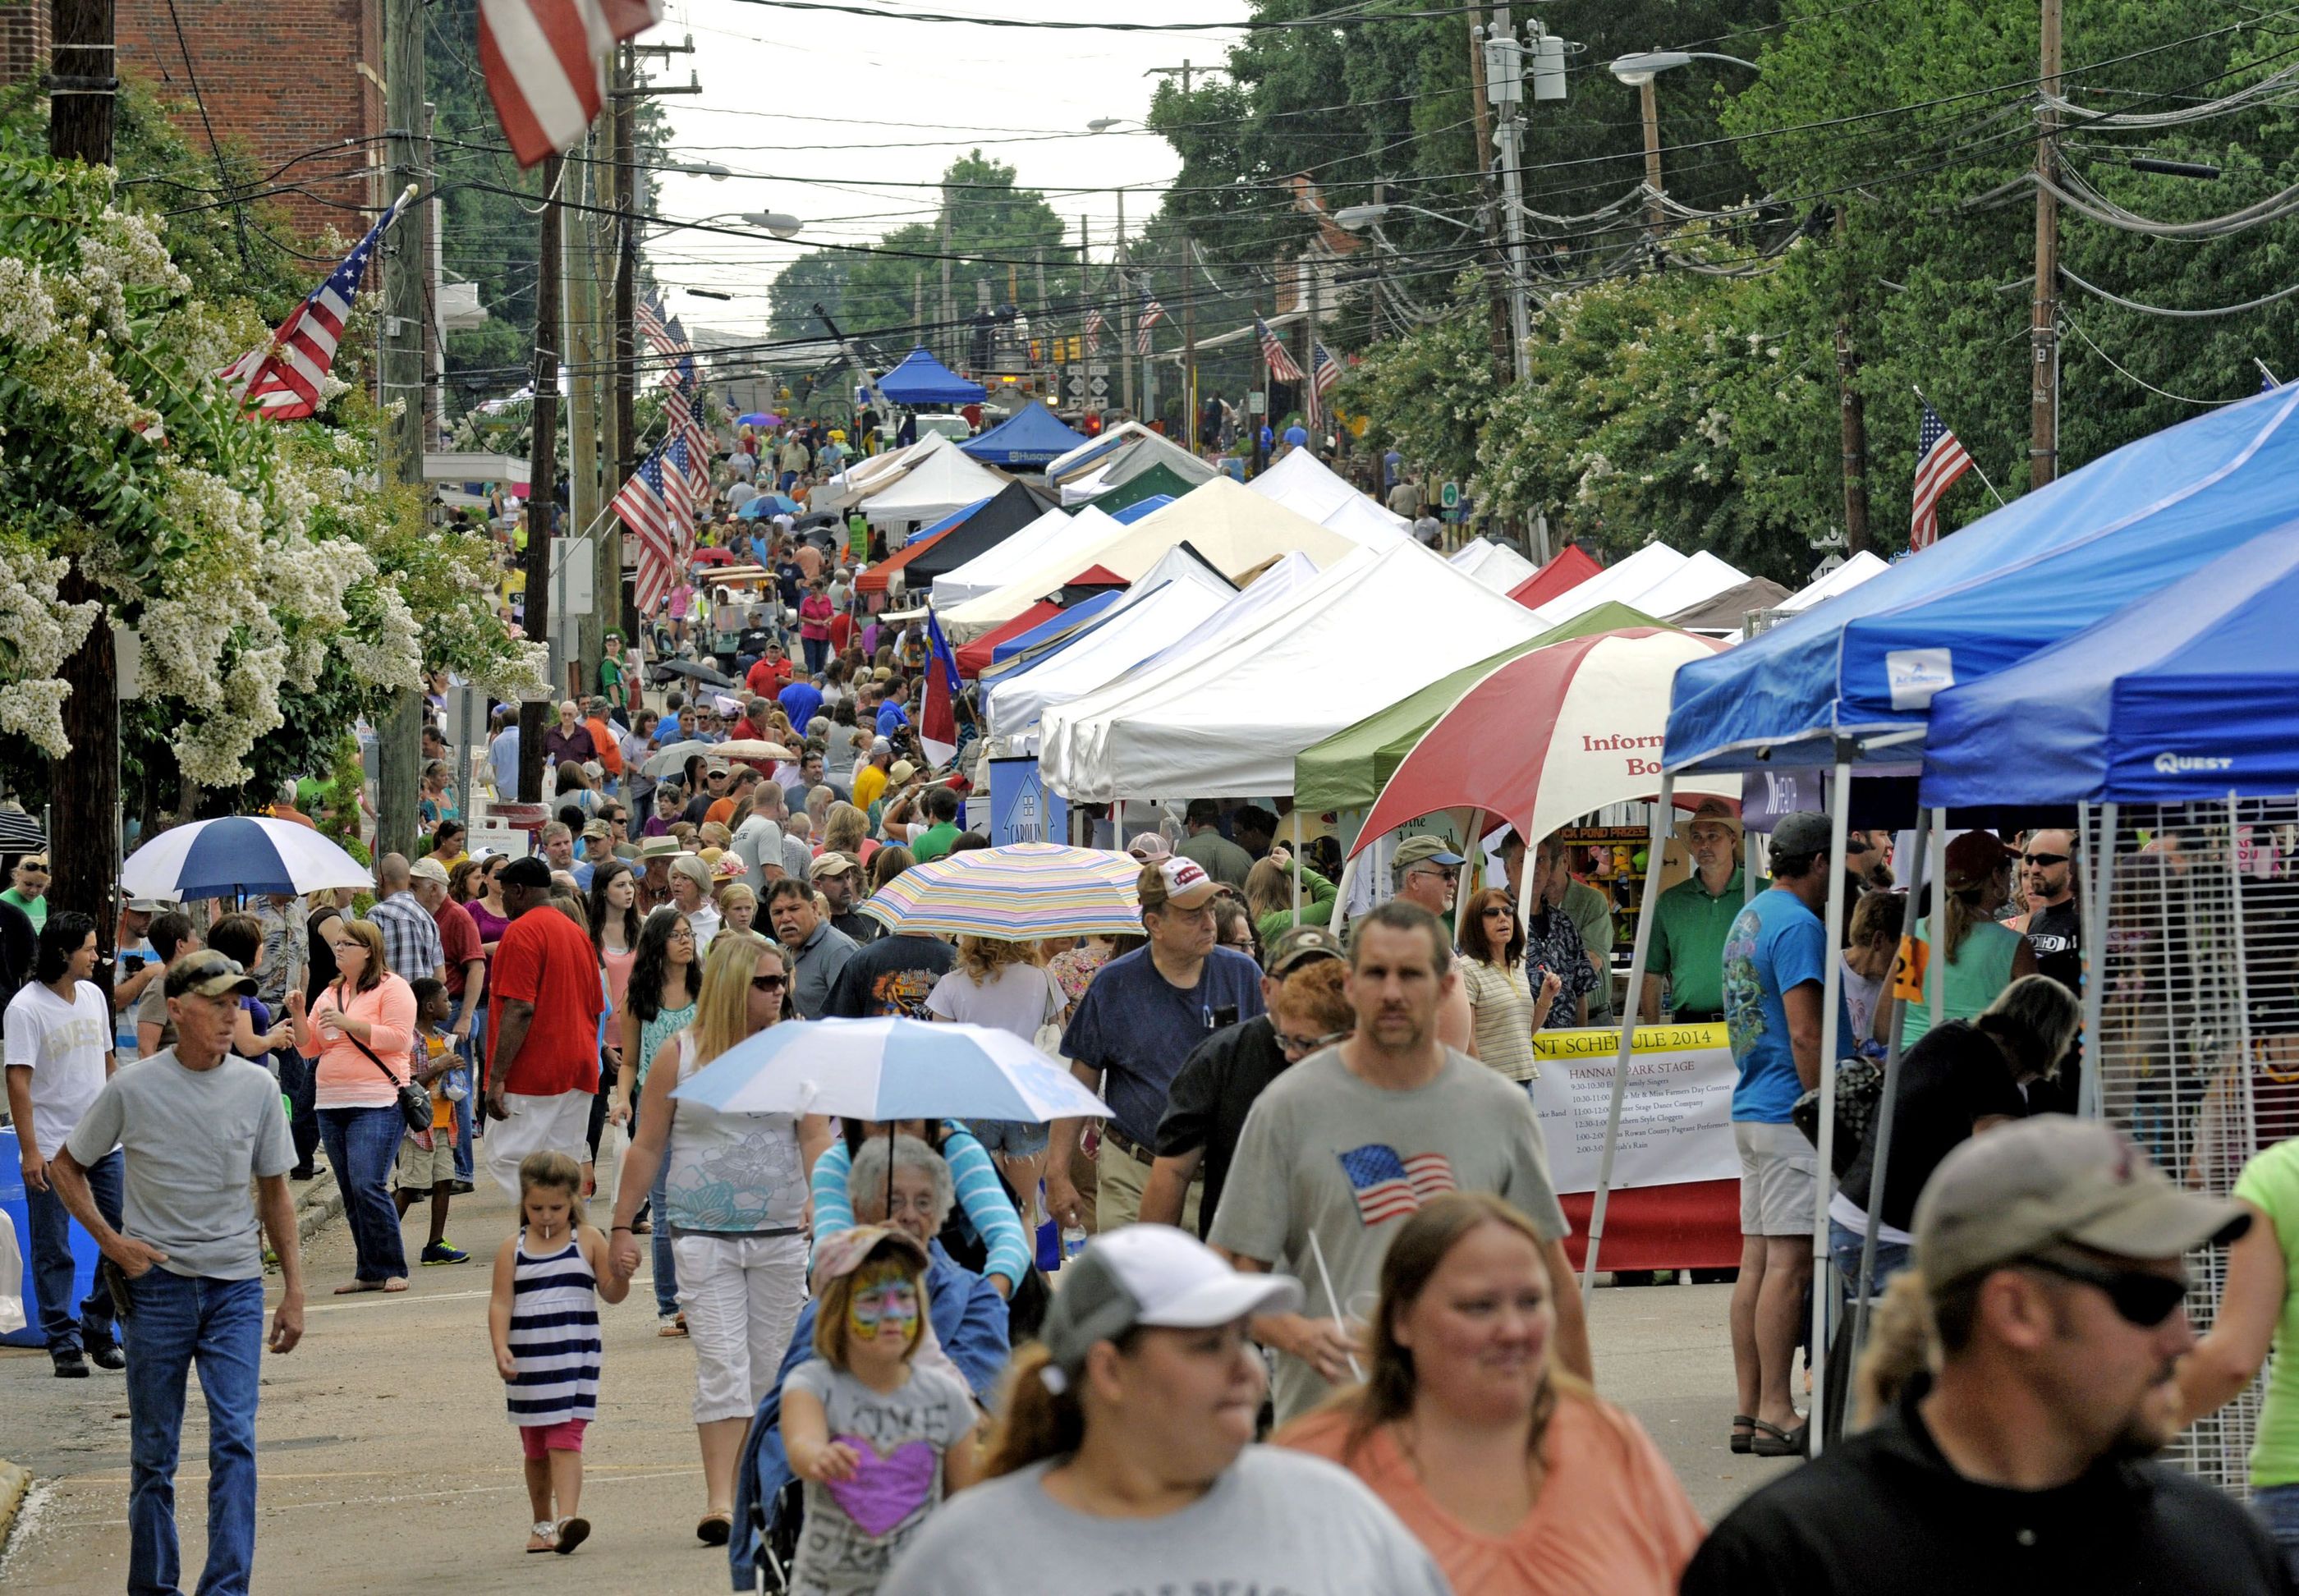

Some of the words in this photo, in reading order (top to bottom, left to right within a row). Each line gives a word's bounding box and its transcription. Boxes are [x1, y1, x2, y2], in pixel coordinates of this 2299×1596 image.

[1582, 733, 1664, 751] Inform
[1626, 758, 1663, 776] Bo
[2154, 752, 2232, 775] QUEST
[1580, 827, 1608, 838] POND
[1610, 825, 1646, 837] PRIZES
[1533, 1039, 1559, 1055] NT
[1566, 1032, 1666, 1054] SCHEULE
[1672, 1030, 1711, 1046] 2014
[1659, 1061, 1695, 1073] STAGE
[1571, 1081, 1605, 1091] 9:30-10:30
[1647, 1078, 1669, 1086] Singers
[1665, 1087, 1690, 1095] Farmers
[1691, 1085, 1705, 1094] Day
[1706, 1084, 1731, 1092] Contest
[1573, 1093, 1610, 1103] 10:30-11:00
[1636, 1103, 1652, 1112] Stage
[1674, 1099, 1704, 1109] Company
[1641, 1115, 1655, 1125] Style
[1657, 1113, 1684, 1123] Cloggers
[1625, 1129, 1646, 1137] Rowan
[1648, 1127, 1670, 1135] County
[1697, 1121, 1729, 1130] Performers
[1576, 1144, 1604, 1153] 2:00-3:0
